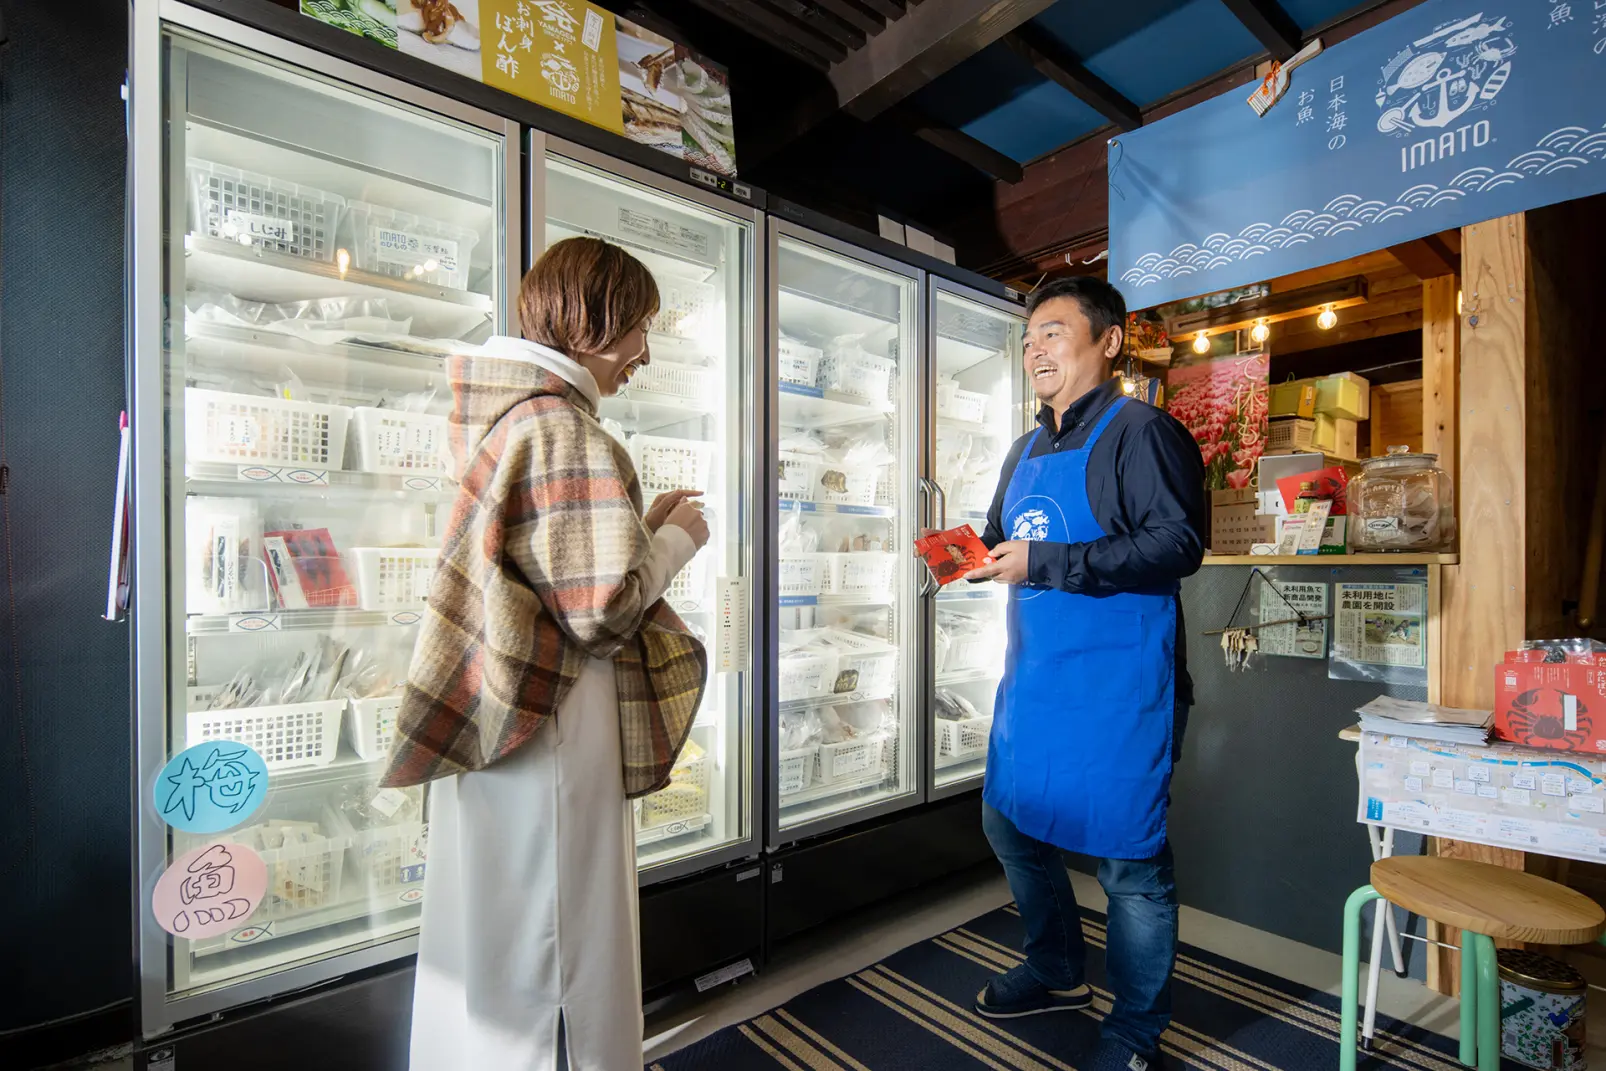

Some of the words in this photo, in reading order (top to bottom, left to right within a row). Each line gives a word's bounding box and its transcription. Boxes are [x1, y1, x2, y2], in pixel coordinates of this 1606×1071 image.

[1547, 0, 1574, 30] 魚
[549, 86, 576, 105] IMATO
[1296, 88, 1315, 127] お魚
[1326, 75, 1348, 150] 日本海の
[1401, 120, 1490, 173] IMATO
[250, 221, 287, 239] しじみ
[380, 231, 407, 244] IMATO
[1232, 291, 1266, 488] 山で休もう。
[1283, 585, 1322, 593] 未利用魚で
[1342, 590, 1395, 600] 未利用地に
[1342, 600, 1395, 610] 農園を開設
